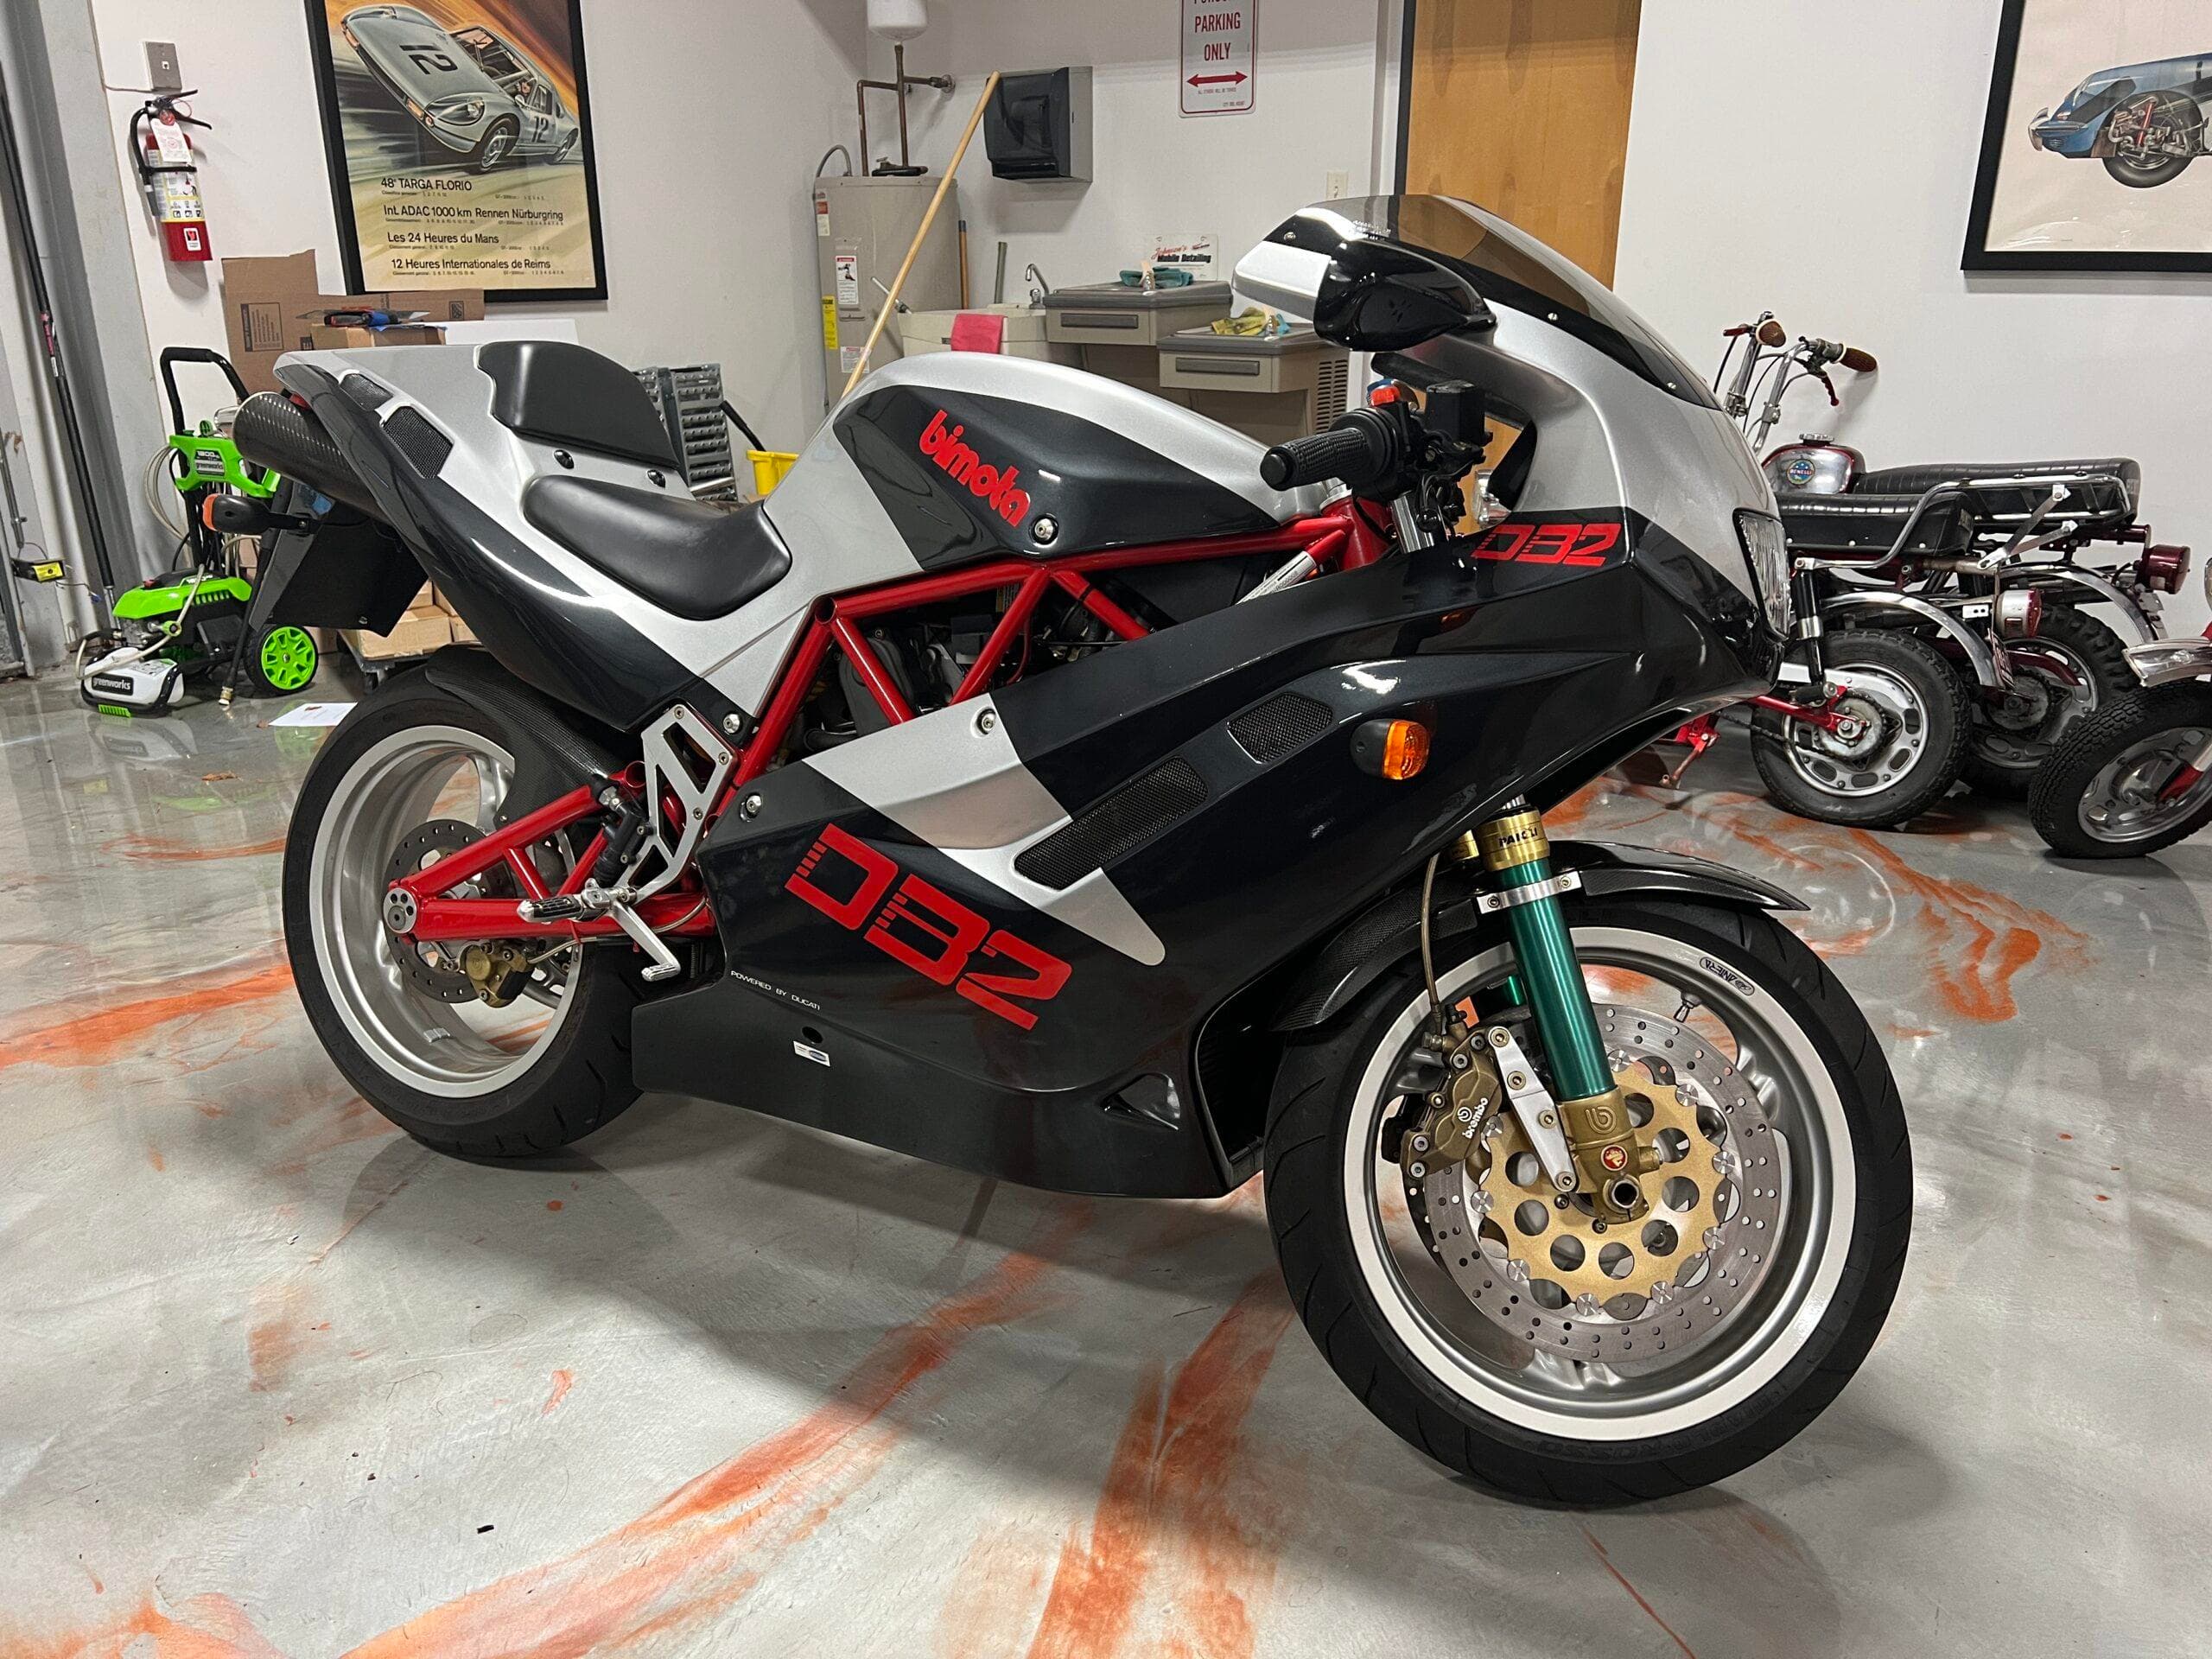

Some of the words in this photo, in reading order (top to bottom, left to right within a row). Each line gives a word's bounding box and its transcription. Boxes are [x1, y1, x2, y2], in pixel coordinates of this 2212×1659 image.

[1194, 12, 1241, 33] PARKING
[399, 44, 459, 75] 12
[1204, 42, 1231, 61] ONLY
[531, 116, 550, 143] 12
[397, 178, 433, 190] TARGA
[435, 180, 473, 191] FLORIO
[401, 206, 430, 217] ADAC
[431, 207, 455, 217] 1000
[457, 207, 473, 218] km
[475, 207, 510, 219] Rennen
[512, 208, 563, 222] Nürburgring
[387, 232, 406, 243] Les
[408, 232, 422, 243] 24
[423, 232, 459, 243] Heures
[460, 233, 473, 243] du
[474, 233, 499, 244] Mans
[391, 258, 404, 269] 12
[405, 258, 441, 269] Heures
[442, 258, 509, 269] Internationales
[511, 259, 523, 269] de
[524, 258, 551, 269] Reims
[918, 409, 1031, 527] bimota
[1470, 523, 1622, 567] DB2
[92, 677, 131, 690] greenworks
[785, 822, 1072, 1031] DB2
[730, 969, 772, 991] POWERED
[775, 988, 787, 996] BY
[791, 994, 821, 1011] DUCATI
[1462, 1097, 1489, 1140] brembo
